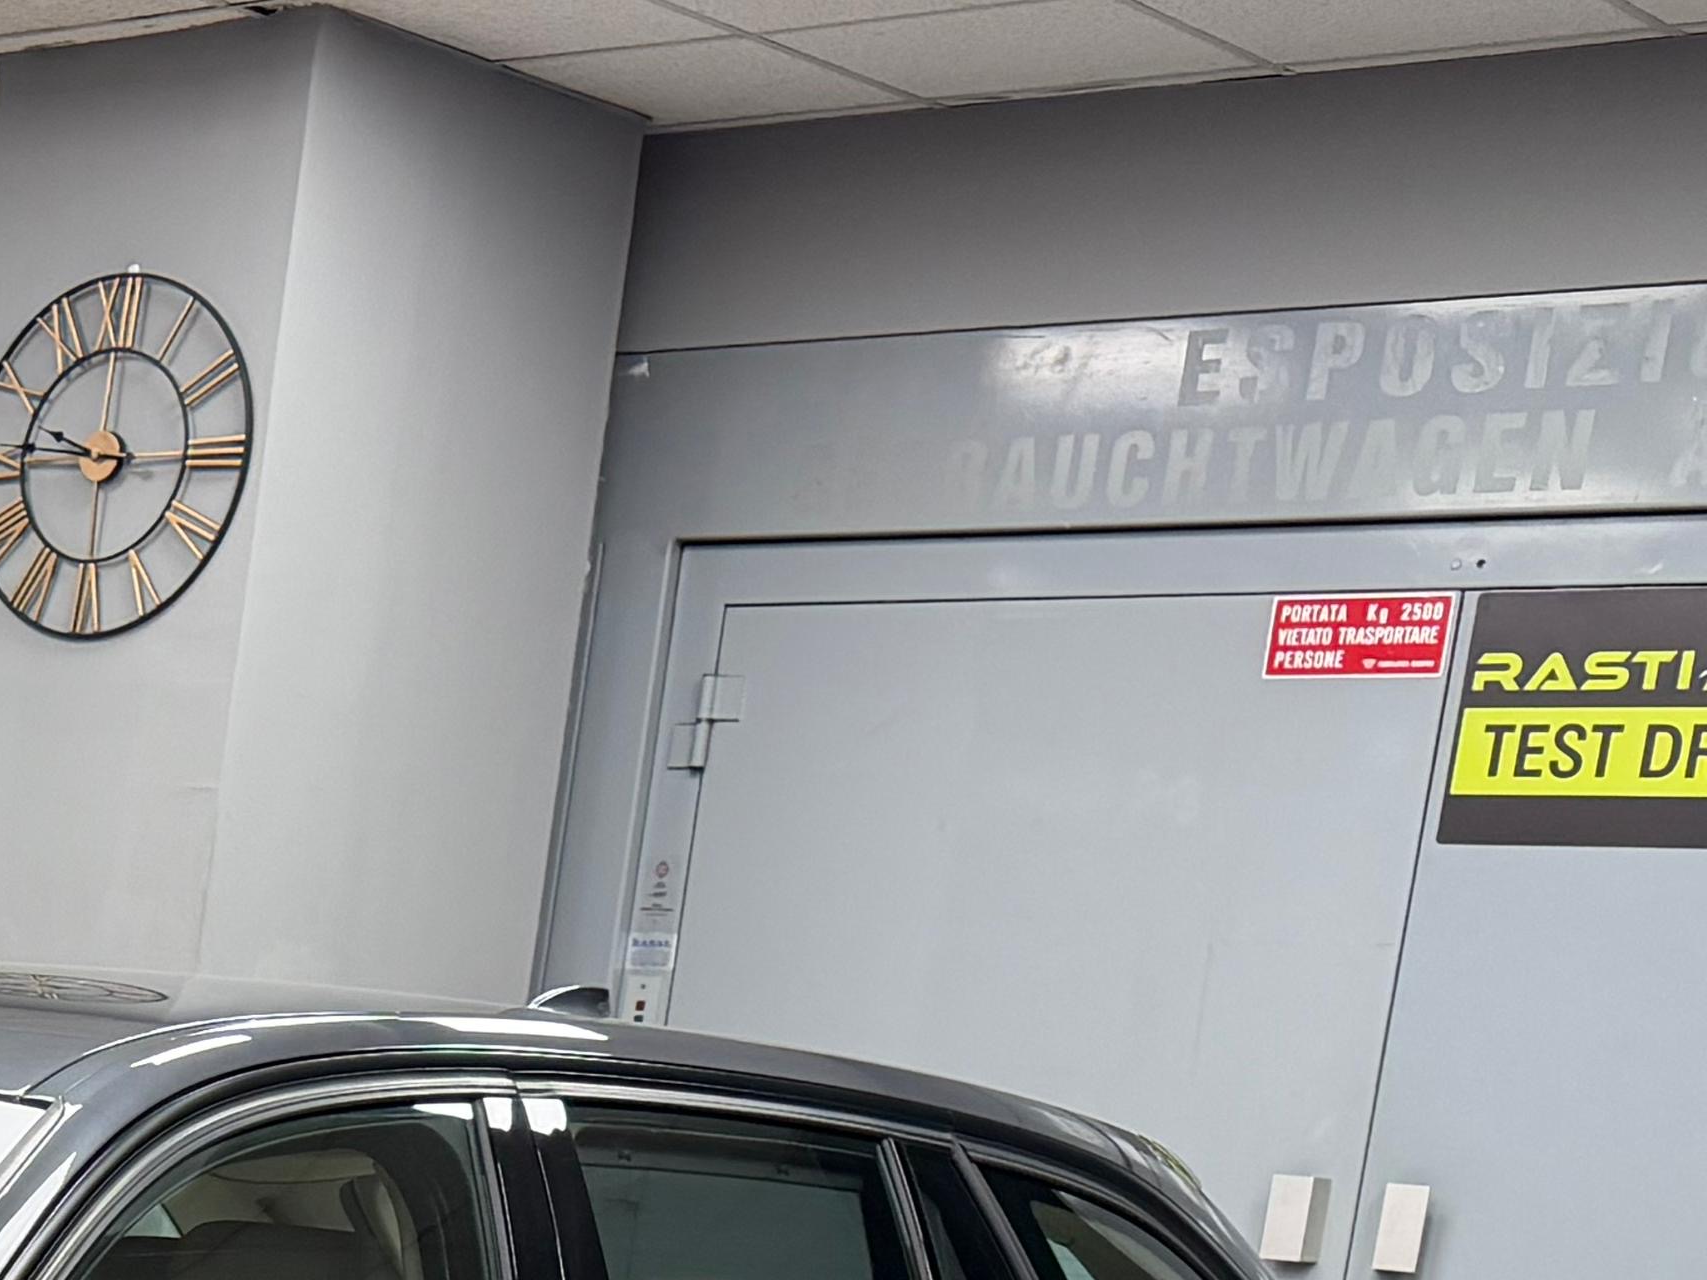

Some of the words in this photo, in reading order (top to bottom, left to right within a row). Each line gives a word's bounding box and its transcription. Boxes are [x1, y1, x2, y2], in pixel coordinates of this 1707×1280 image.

[1280, 604, 1348, 623] PORTATA
[1366, 603, 1389, 624] Kg
[1400, 602, 1445, 622] 2500
[1278, 627, 1333, 646] VIETATO
[1338, 625, 1440, 645] TRASPORTARE
[1274, 651, 1344, 669] PERSONE
[1471, 650, 1696, 692] RASTI
[1484, 723, 1626, 779] TEST
